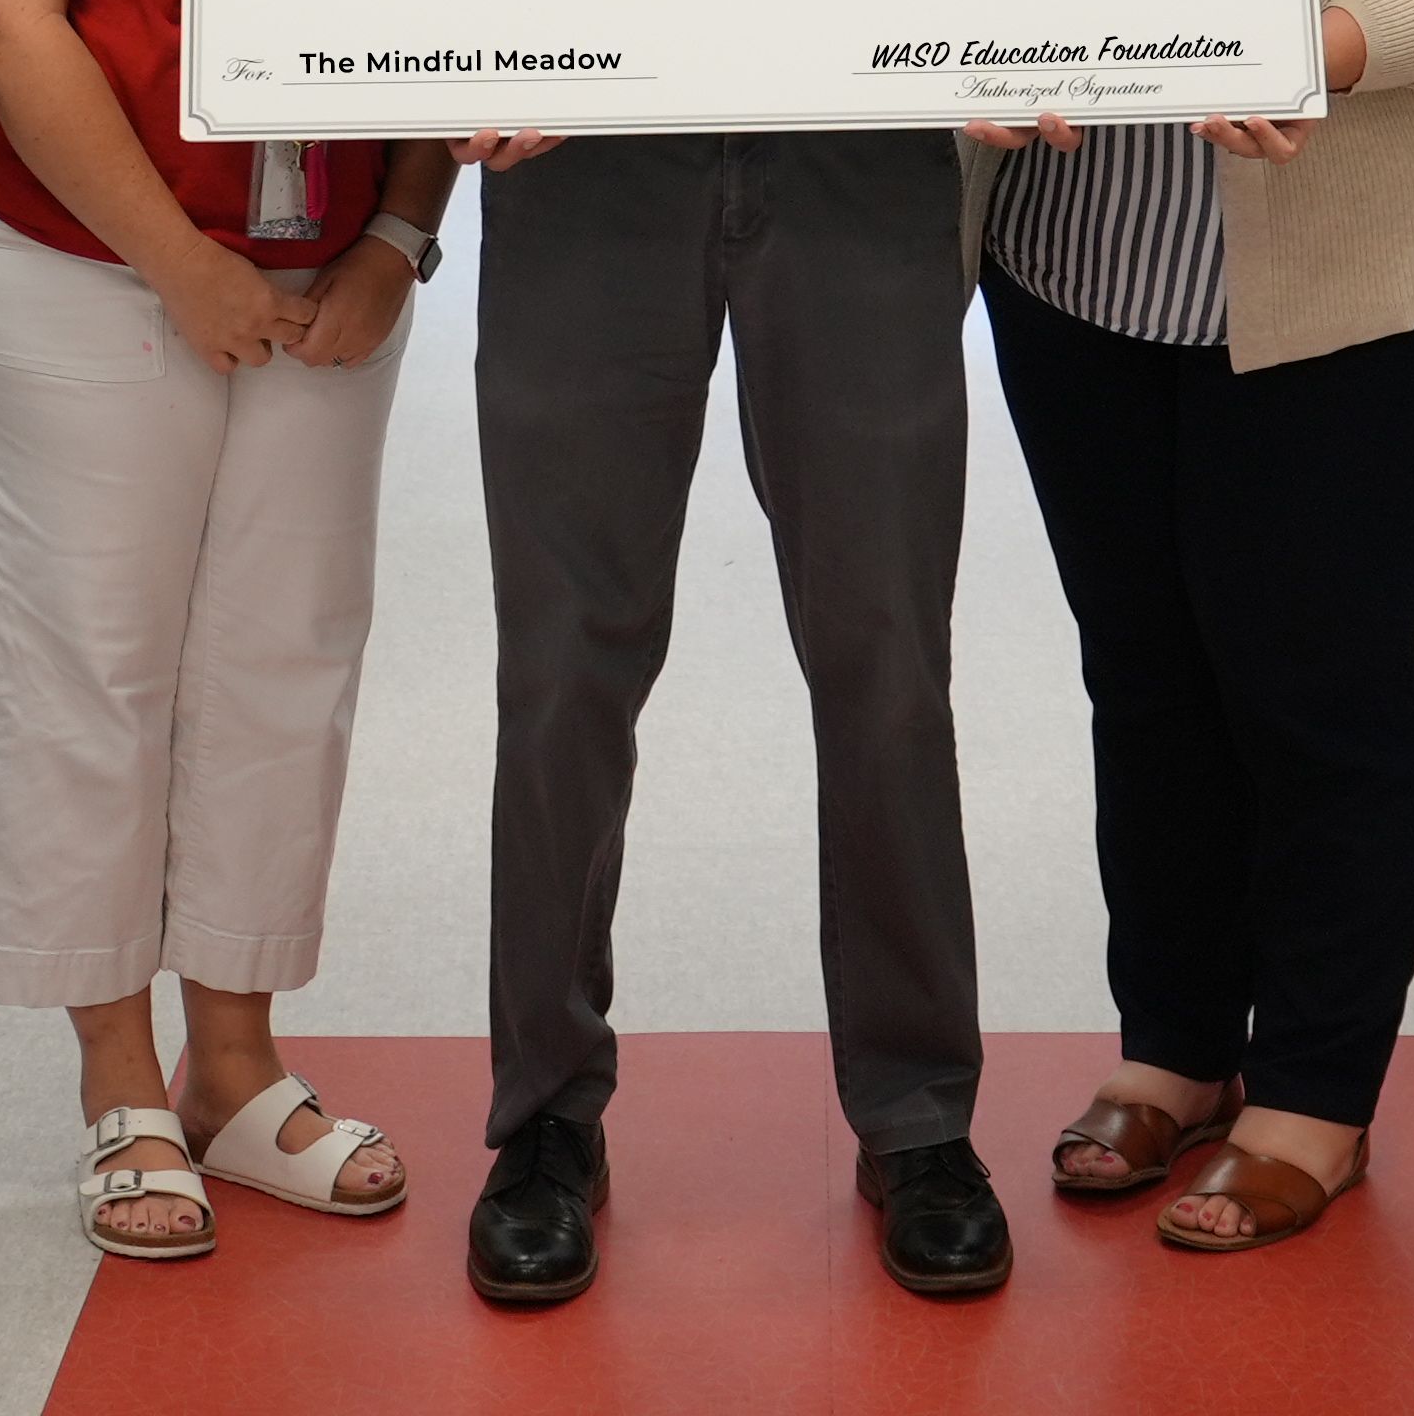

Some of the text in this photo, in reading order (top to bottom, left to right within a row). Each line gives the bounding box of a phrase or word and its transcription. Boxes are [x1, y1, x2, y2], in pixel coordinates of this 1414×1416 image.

[221, 48, 622, 83] For: The Mindful Meadow
[871, 35, 1244, 70] WASD Education Foundation
[955, 74, 1163, 106] Authorized Signature
